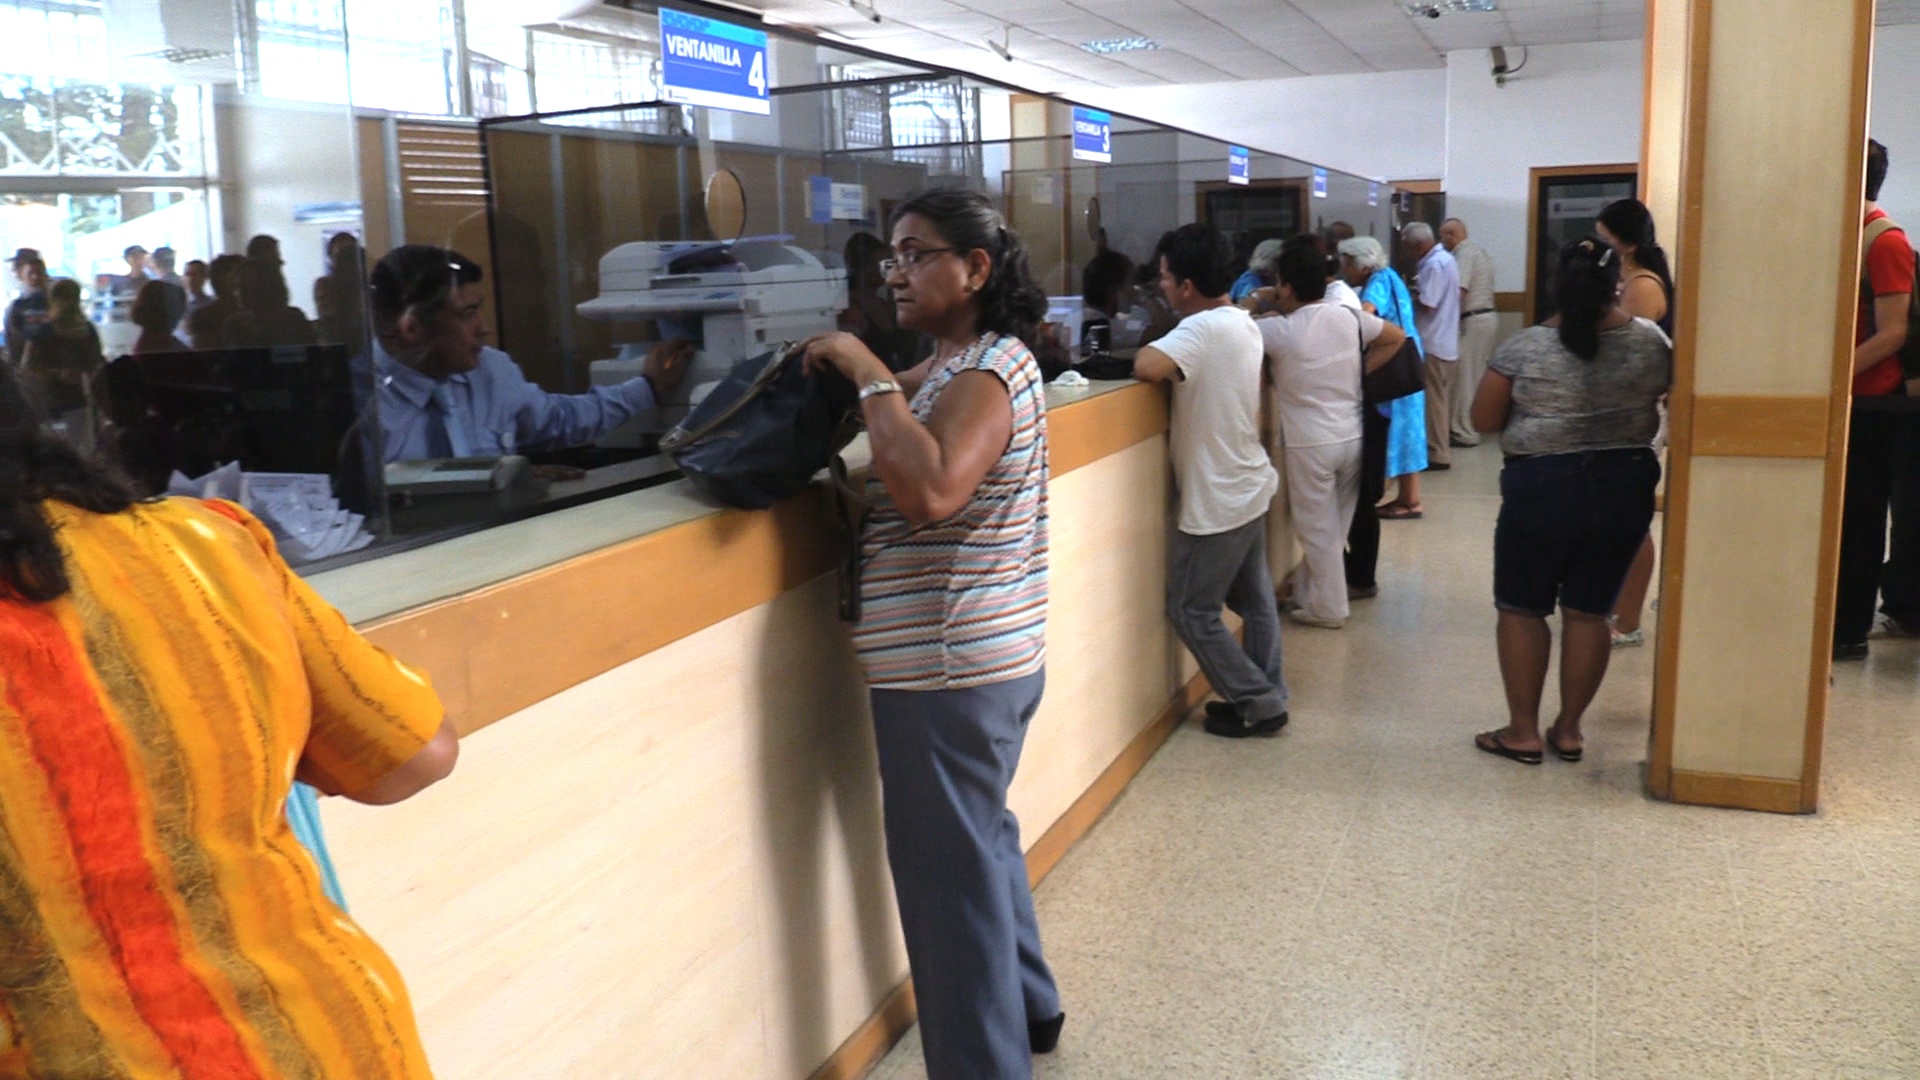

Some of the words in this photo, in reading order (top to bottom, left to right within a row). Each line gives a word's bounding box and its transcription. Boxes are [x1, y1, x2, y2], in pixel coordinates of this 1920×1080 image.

[665, 33, 742, 68] VENTANILLA
[748, 51, 766, 96] 4
[1102, 125, 1110, 152] 3
